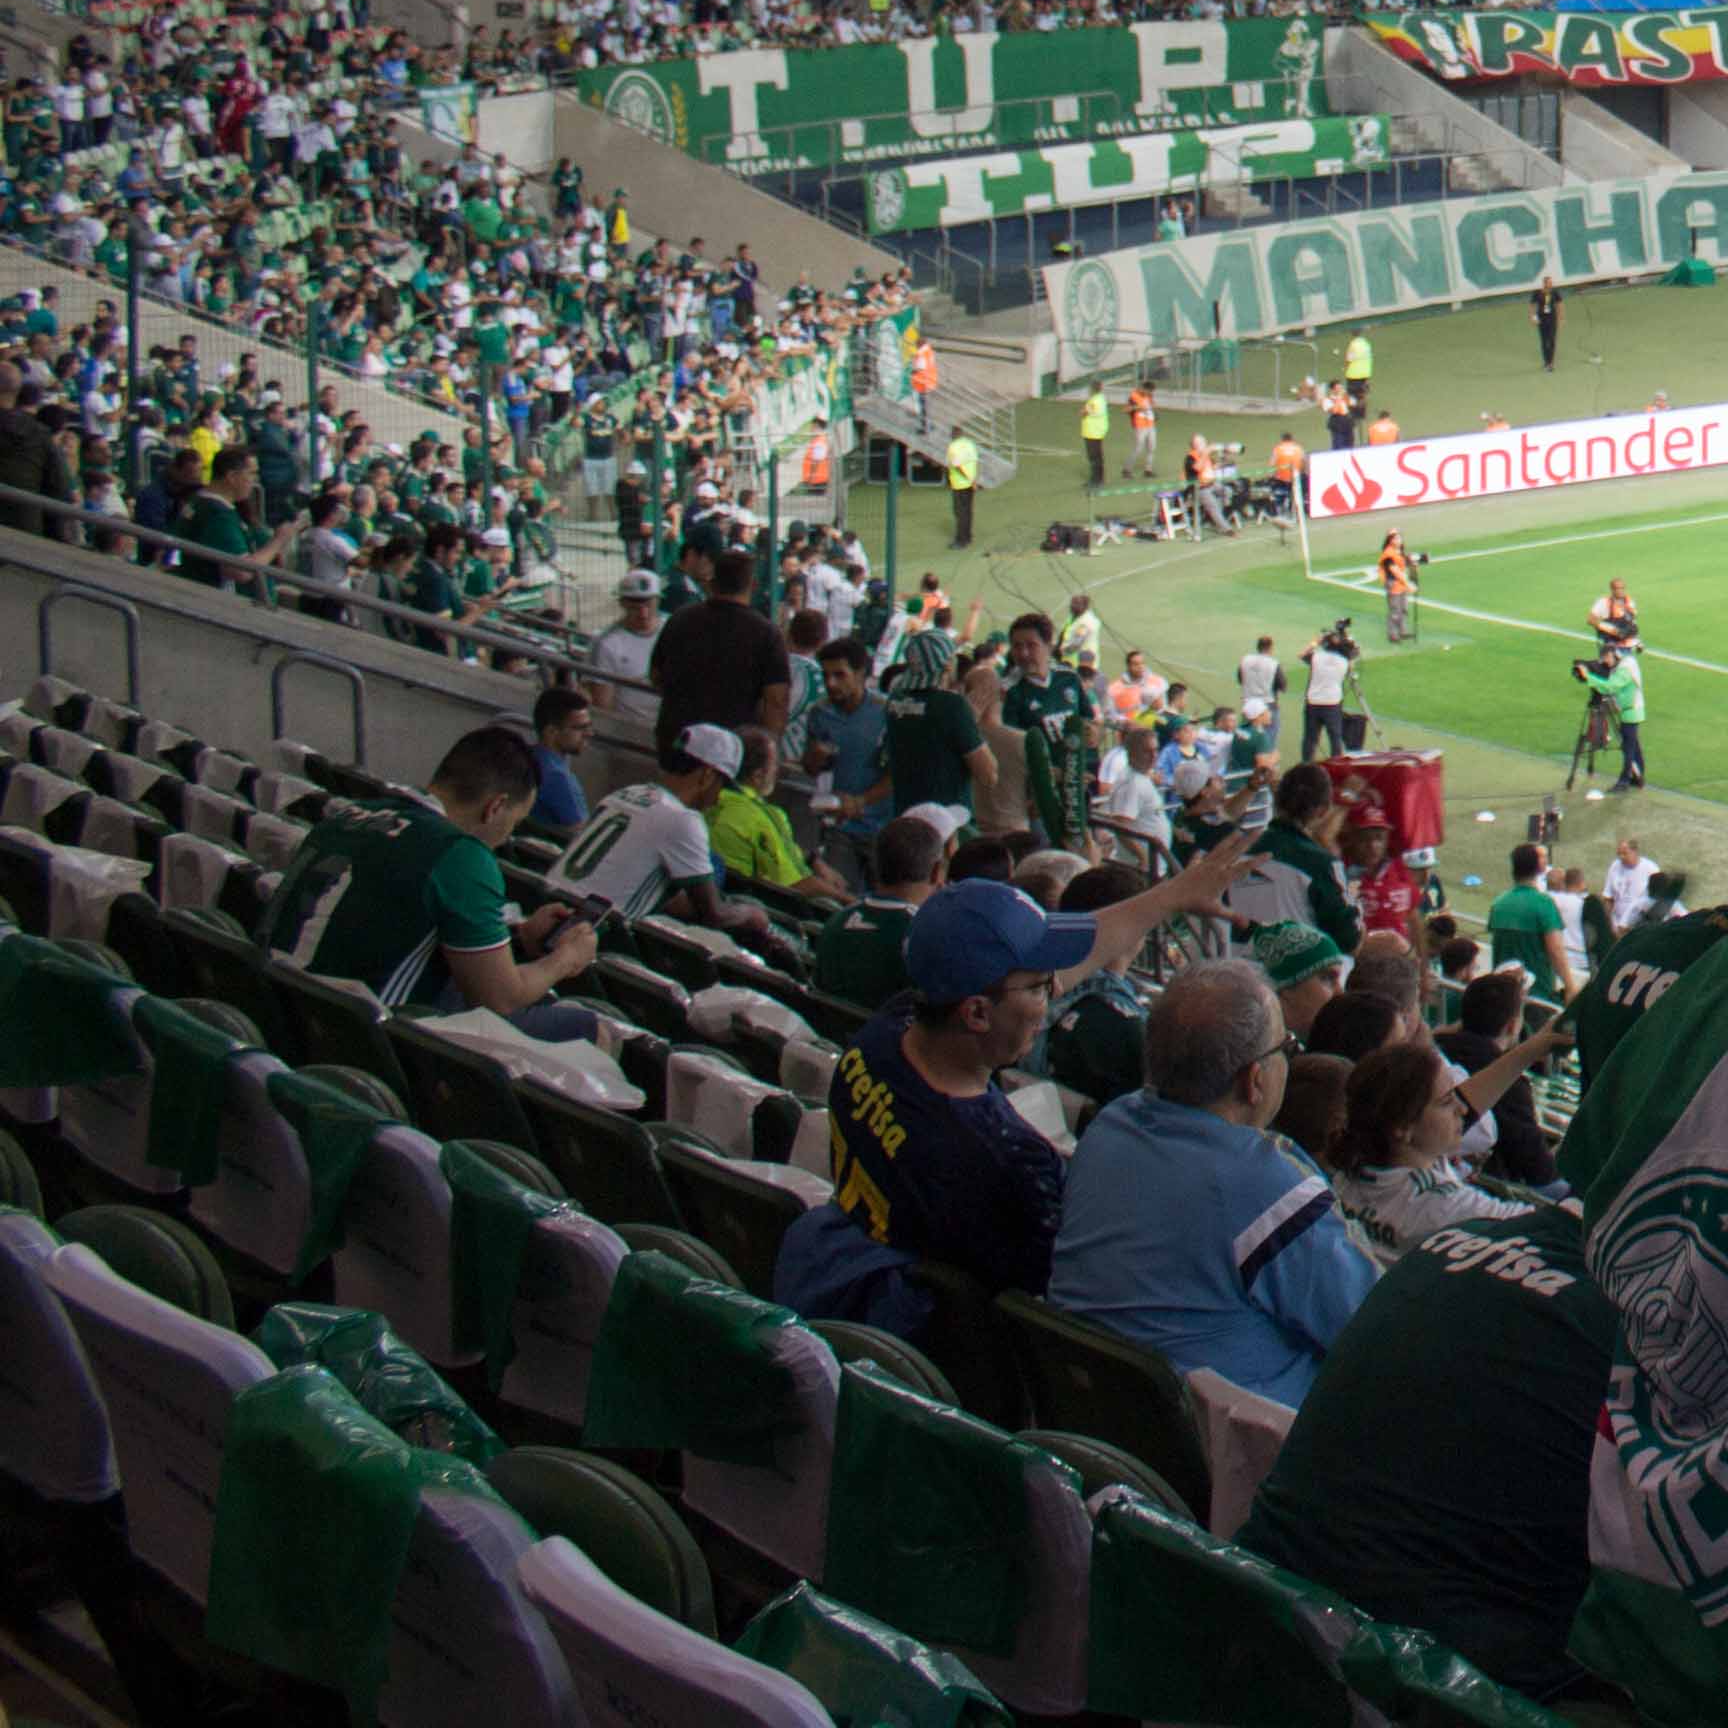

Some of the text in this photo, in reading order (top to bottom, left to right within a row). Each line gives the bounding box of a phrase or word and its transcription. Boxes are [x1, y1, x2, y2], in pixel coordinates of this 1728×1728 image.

[1396, 417, 1720, 506] Santander
[837, 1046, 907, 1162] crefisa
[1419, 1222, 1578, 1297] crefisa
